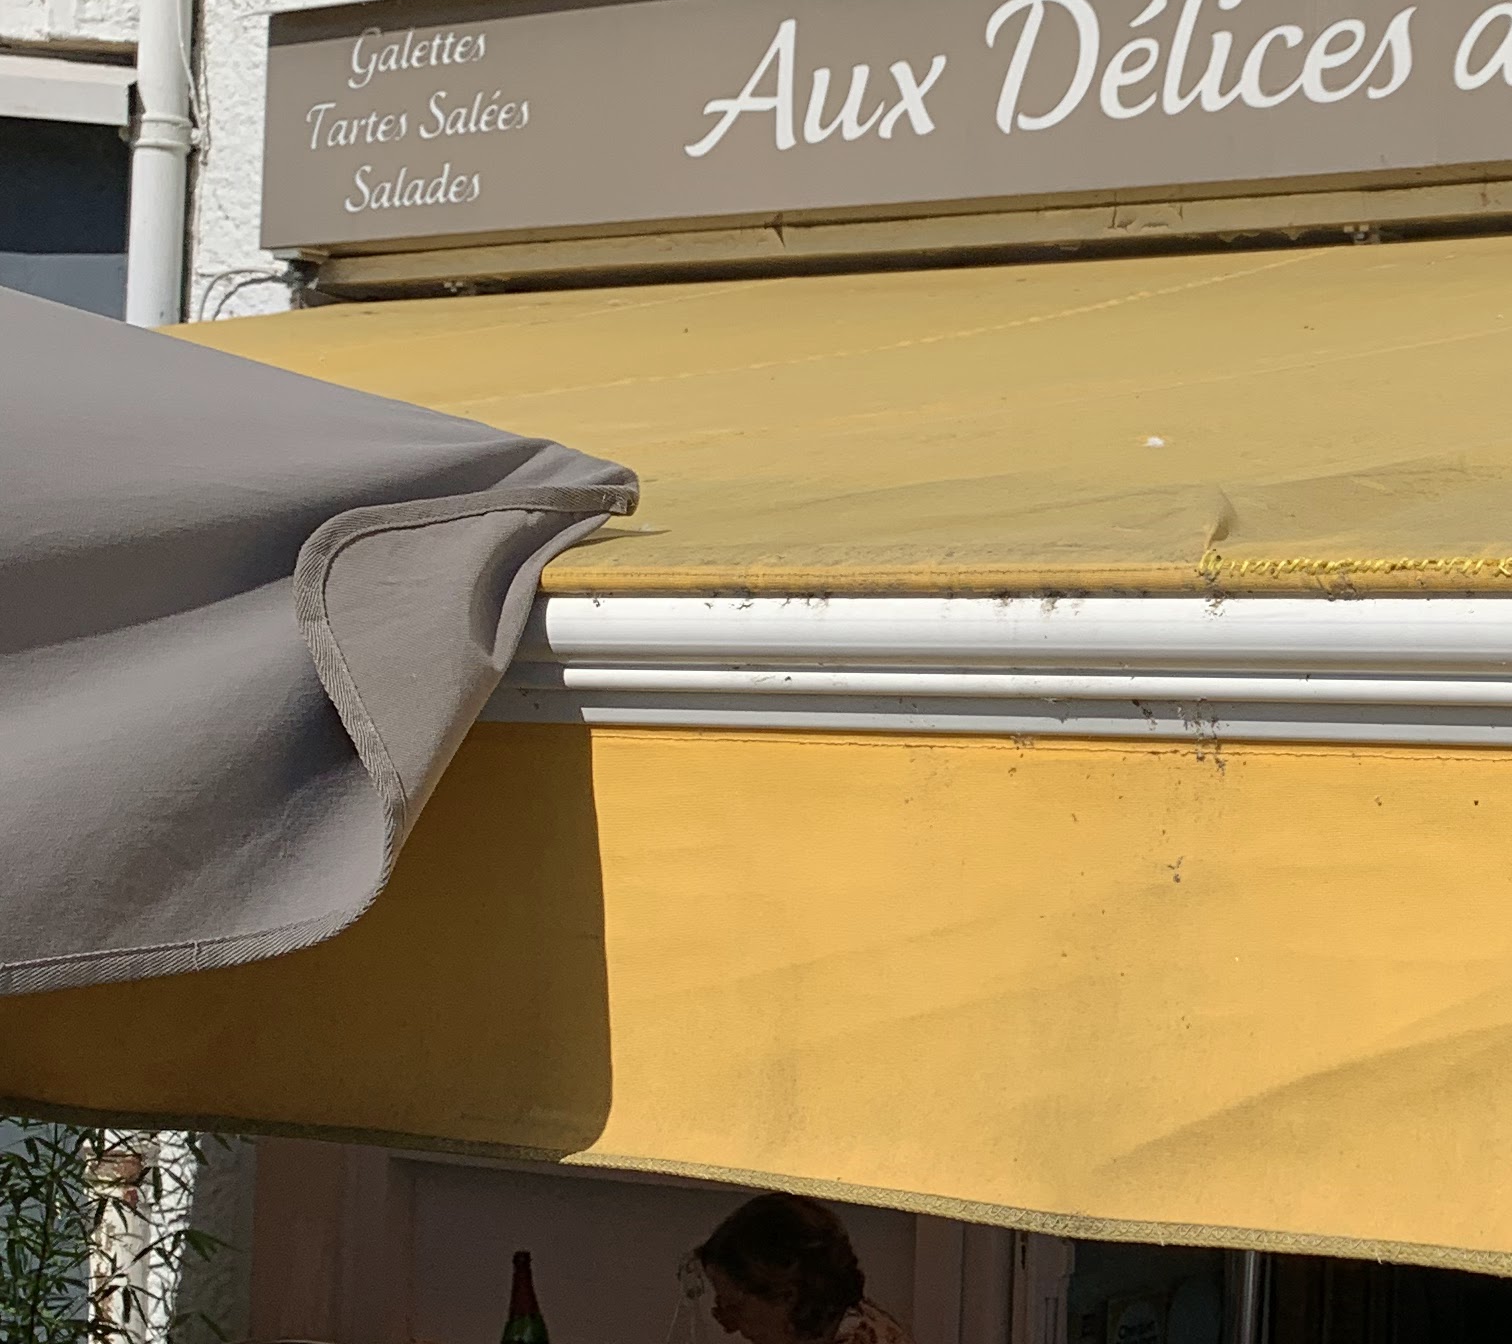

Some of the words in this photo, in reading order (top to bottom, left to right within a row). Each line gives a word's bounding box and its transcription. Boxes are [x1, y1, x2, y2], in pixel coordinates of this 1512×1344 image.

[347, 27, 487, 90] Galettes
[684, 17, 948, 158] Aux
[305, 101, 408, 150] Tartes
[419, 89, 531, 140] Salées
[343, 162, 481, 213] Salades
